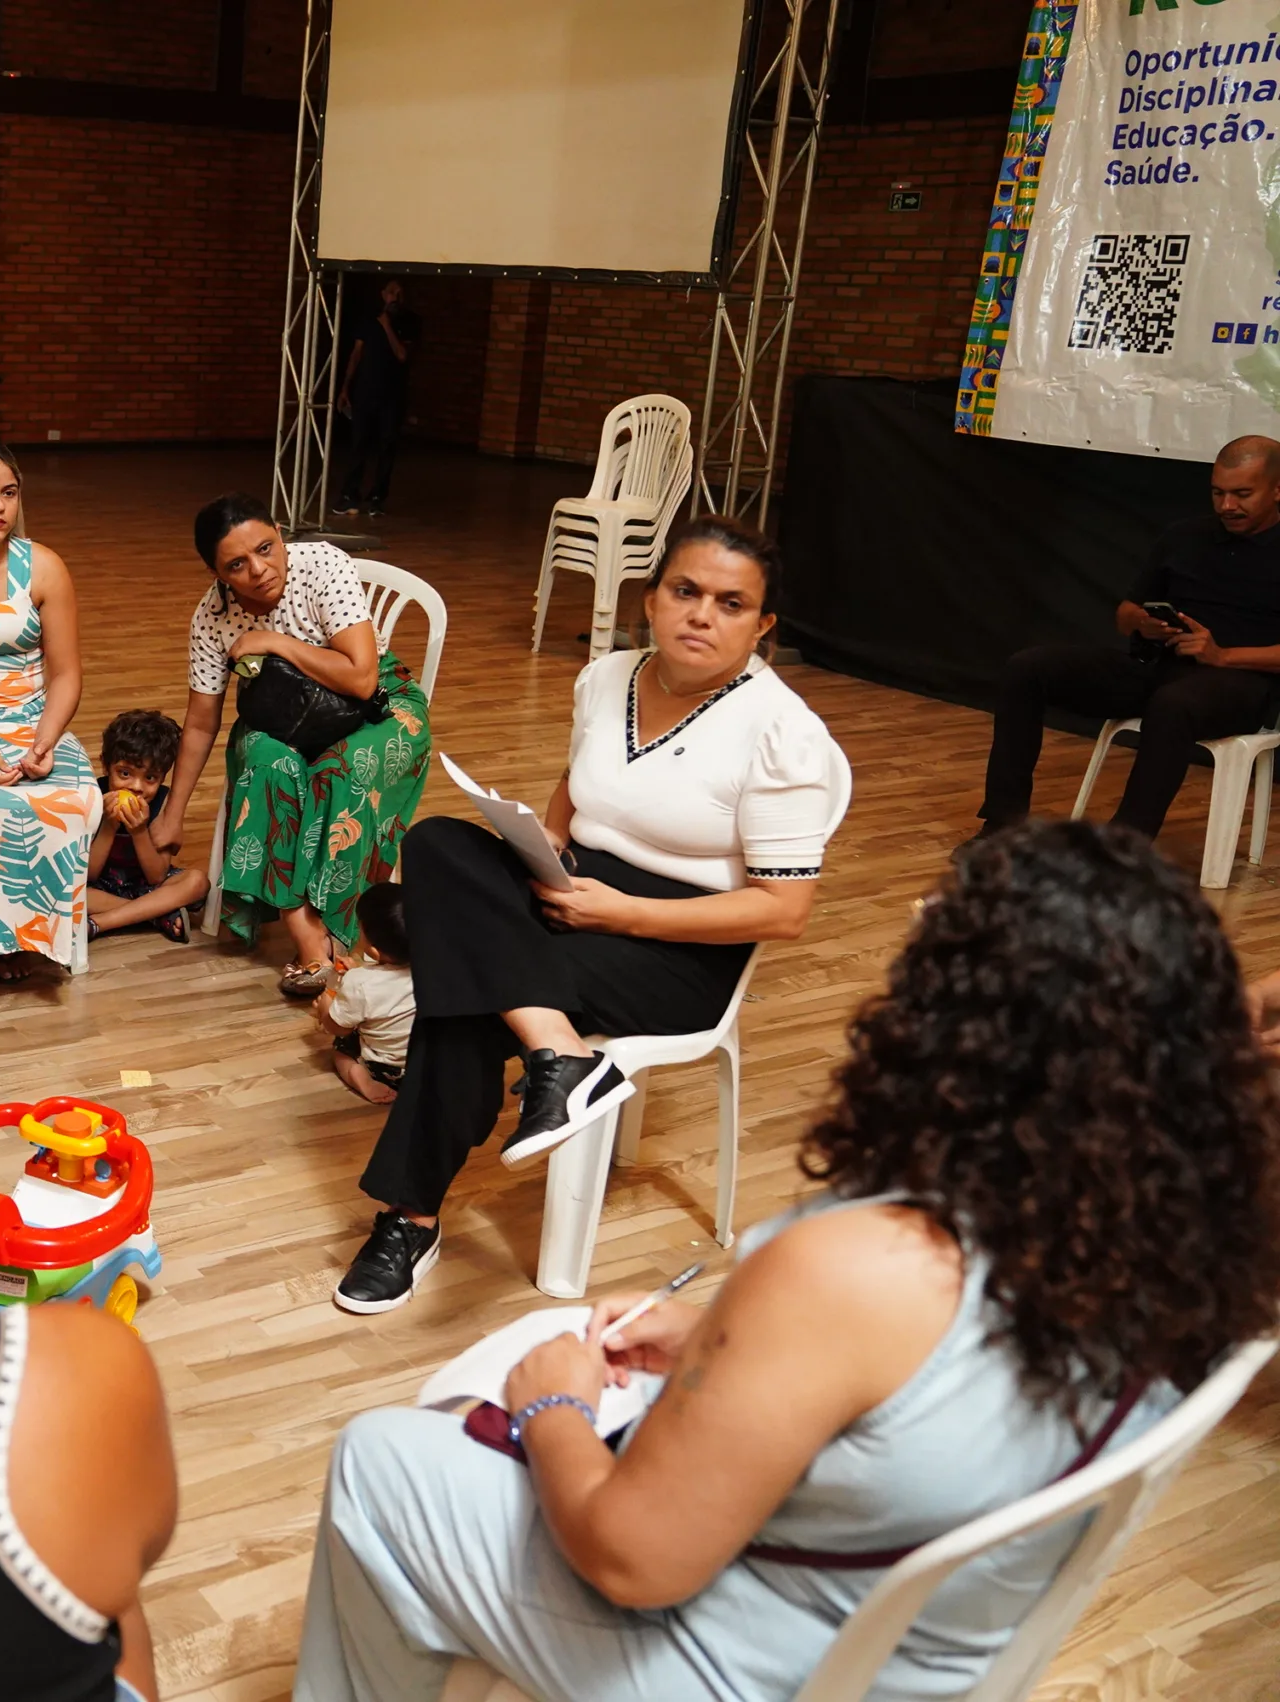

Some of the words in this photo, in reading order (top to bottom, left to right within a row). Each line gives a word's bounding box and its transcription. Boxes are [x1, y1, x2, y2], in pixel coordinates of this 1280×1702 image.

[1125, 32, 1280, 81] Oportuni
[1118, 76, 1280, 114] Disciplina
[1112, 113, 1275, 150] Educação.
[1104, 156, 1199, 186] Saúde.
